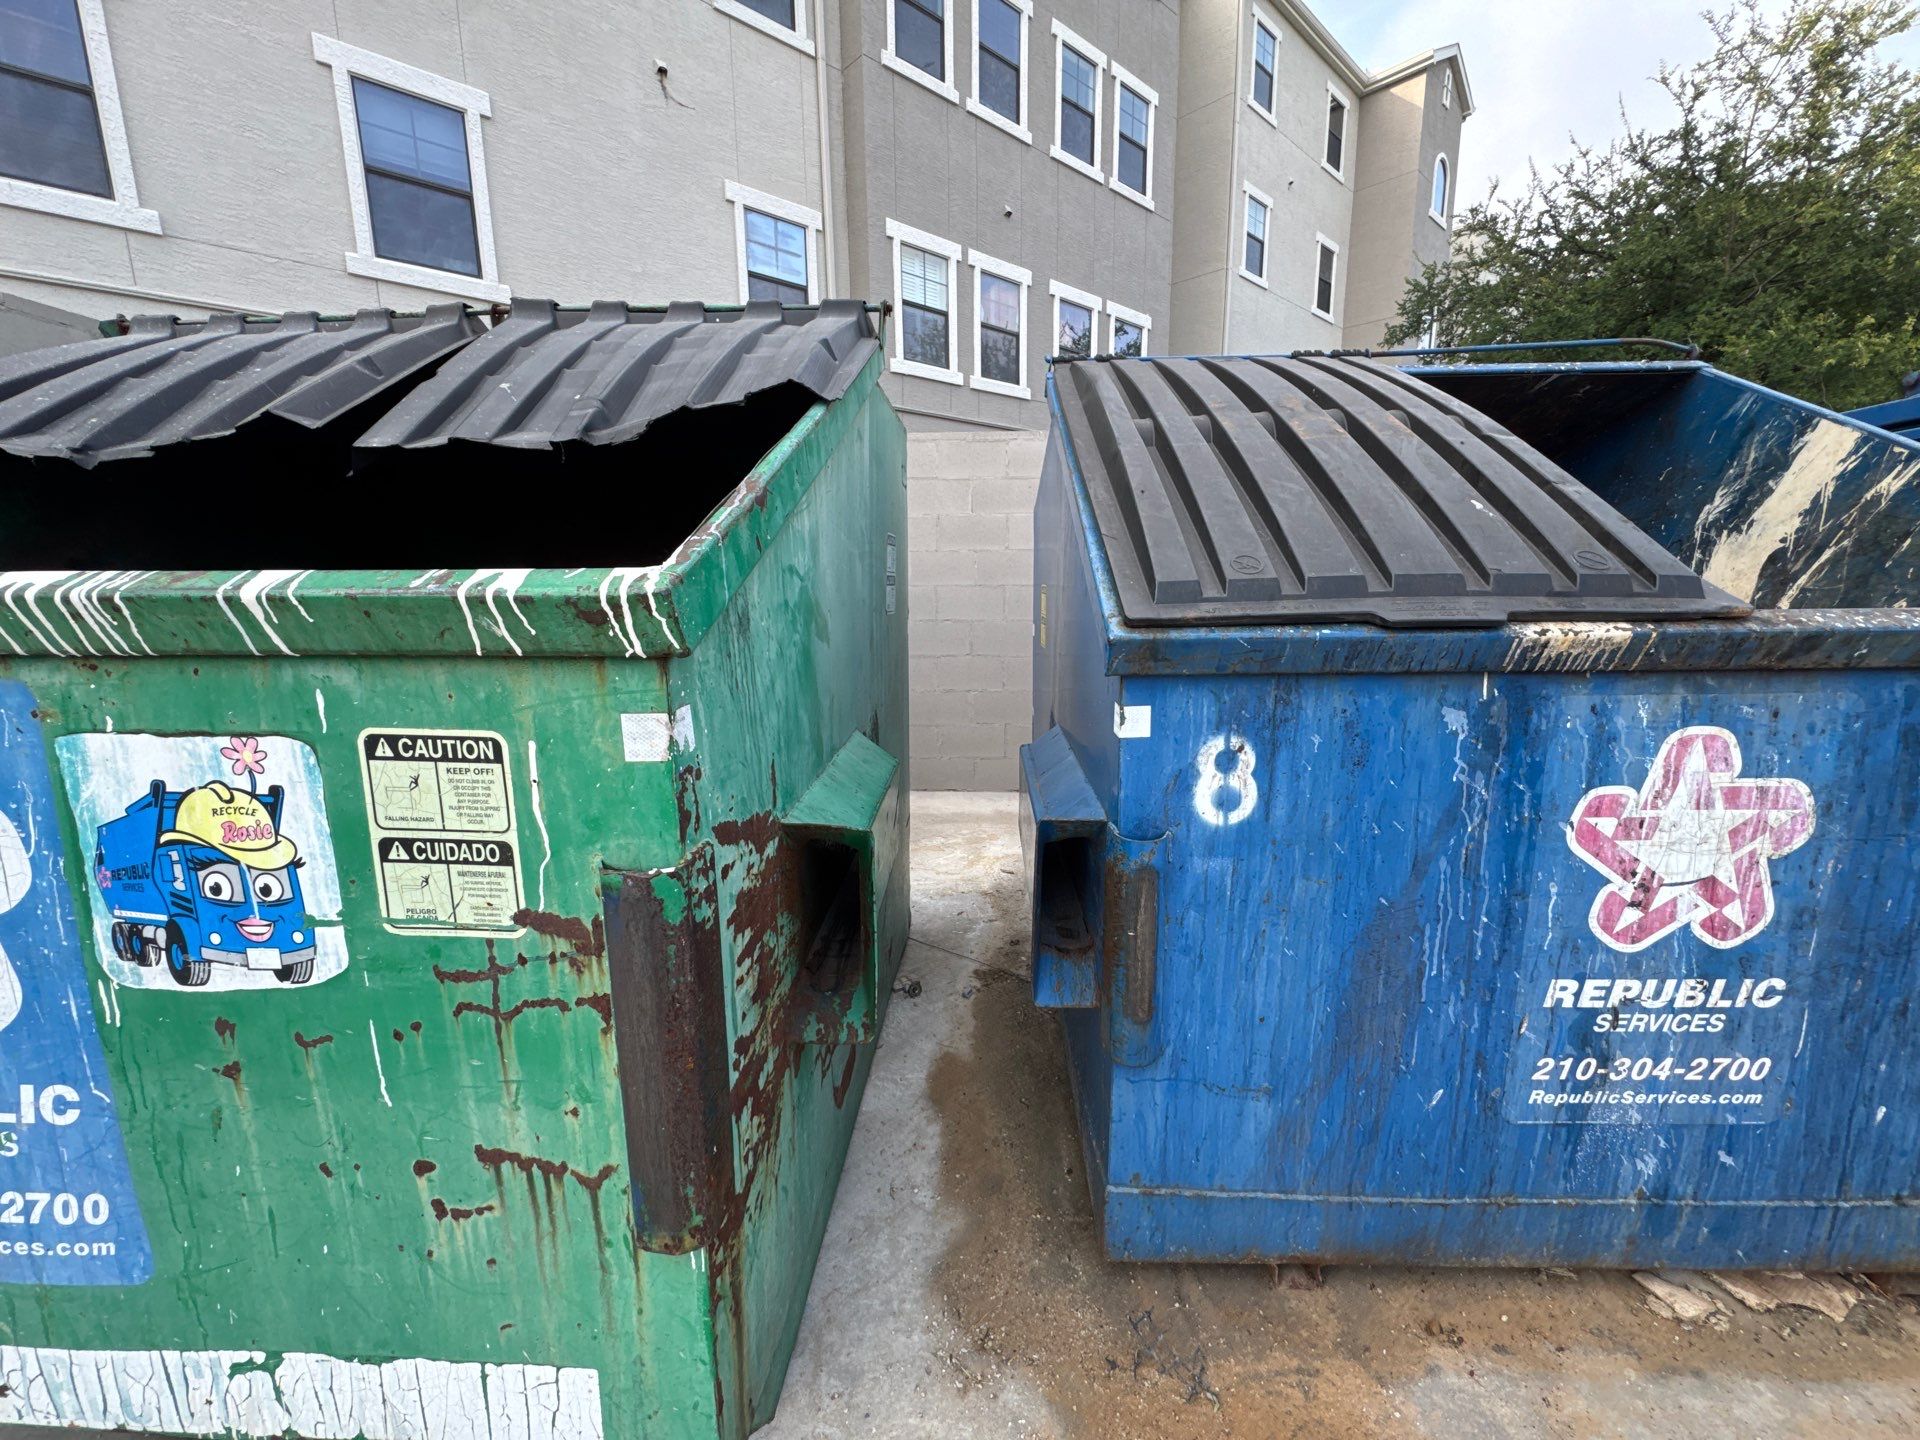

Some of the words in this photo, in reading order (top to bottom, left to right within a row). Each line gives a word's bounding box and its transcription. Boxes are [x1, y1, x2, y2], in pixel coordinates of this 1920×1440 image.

[397, 738, 495, 760] CAUTION
[446, 767, 470, 775] KEEP
[473, 768, 494, 776] OFF!
[1195, 734, 1258, 826] 8
[211, 806, 258, 817] RECYCLE
[221, 819, 273, 844] Rosie
[412, 841, 500, 863] CUIDADO
[111, 862, 150, 880] REPUBLIC
[1543, 977, 1786, 1008] REPUBLIC
[1592, 1013, 1726, 1033] SERVICES
[1531, 1057, 1772, 1081] 210-304-2700
[1528, 1089, 1763, 1107] RepublicServices.com
[0, 1191, 110, 1225] 2700
